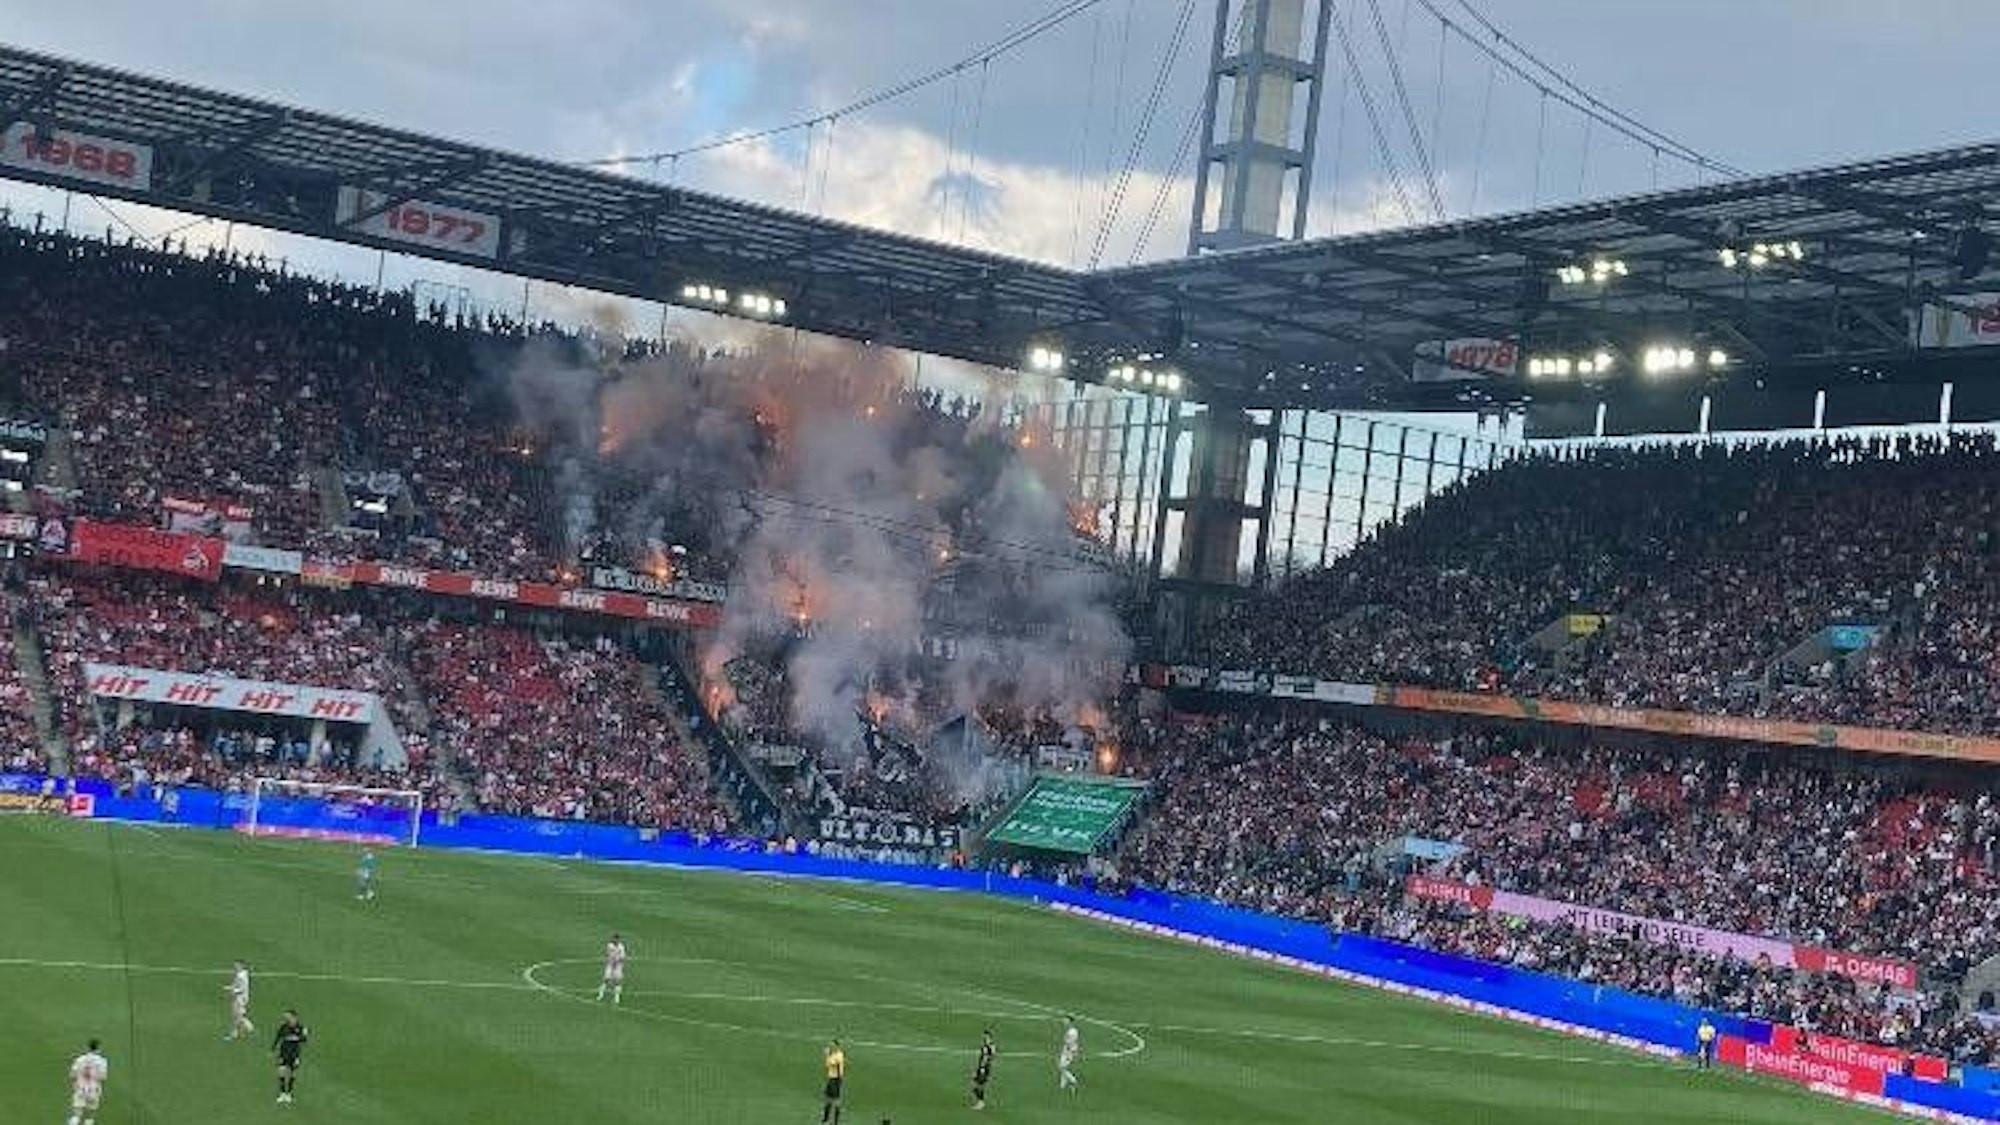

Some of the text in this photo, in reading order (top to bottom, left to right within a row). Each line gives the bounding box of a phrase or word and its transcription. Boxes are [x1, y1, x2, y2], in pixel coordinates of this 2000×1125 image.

[386, 206, 486, 243] 1977
[90, 674, 365, 718] HIT HIT HIT HIT
[1846, 958, 1908, 985] OSMAB
